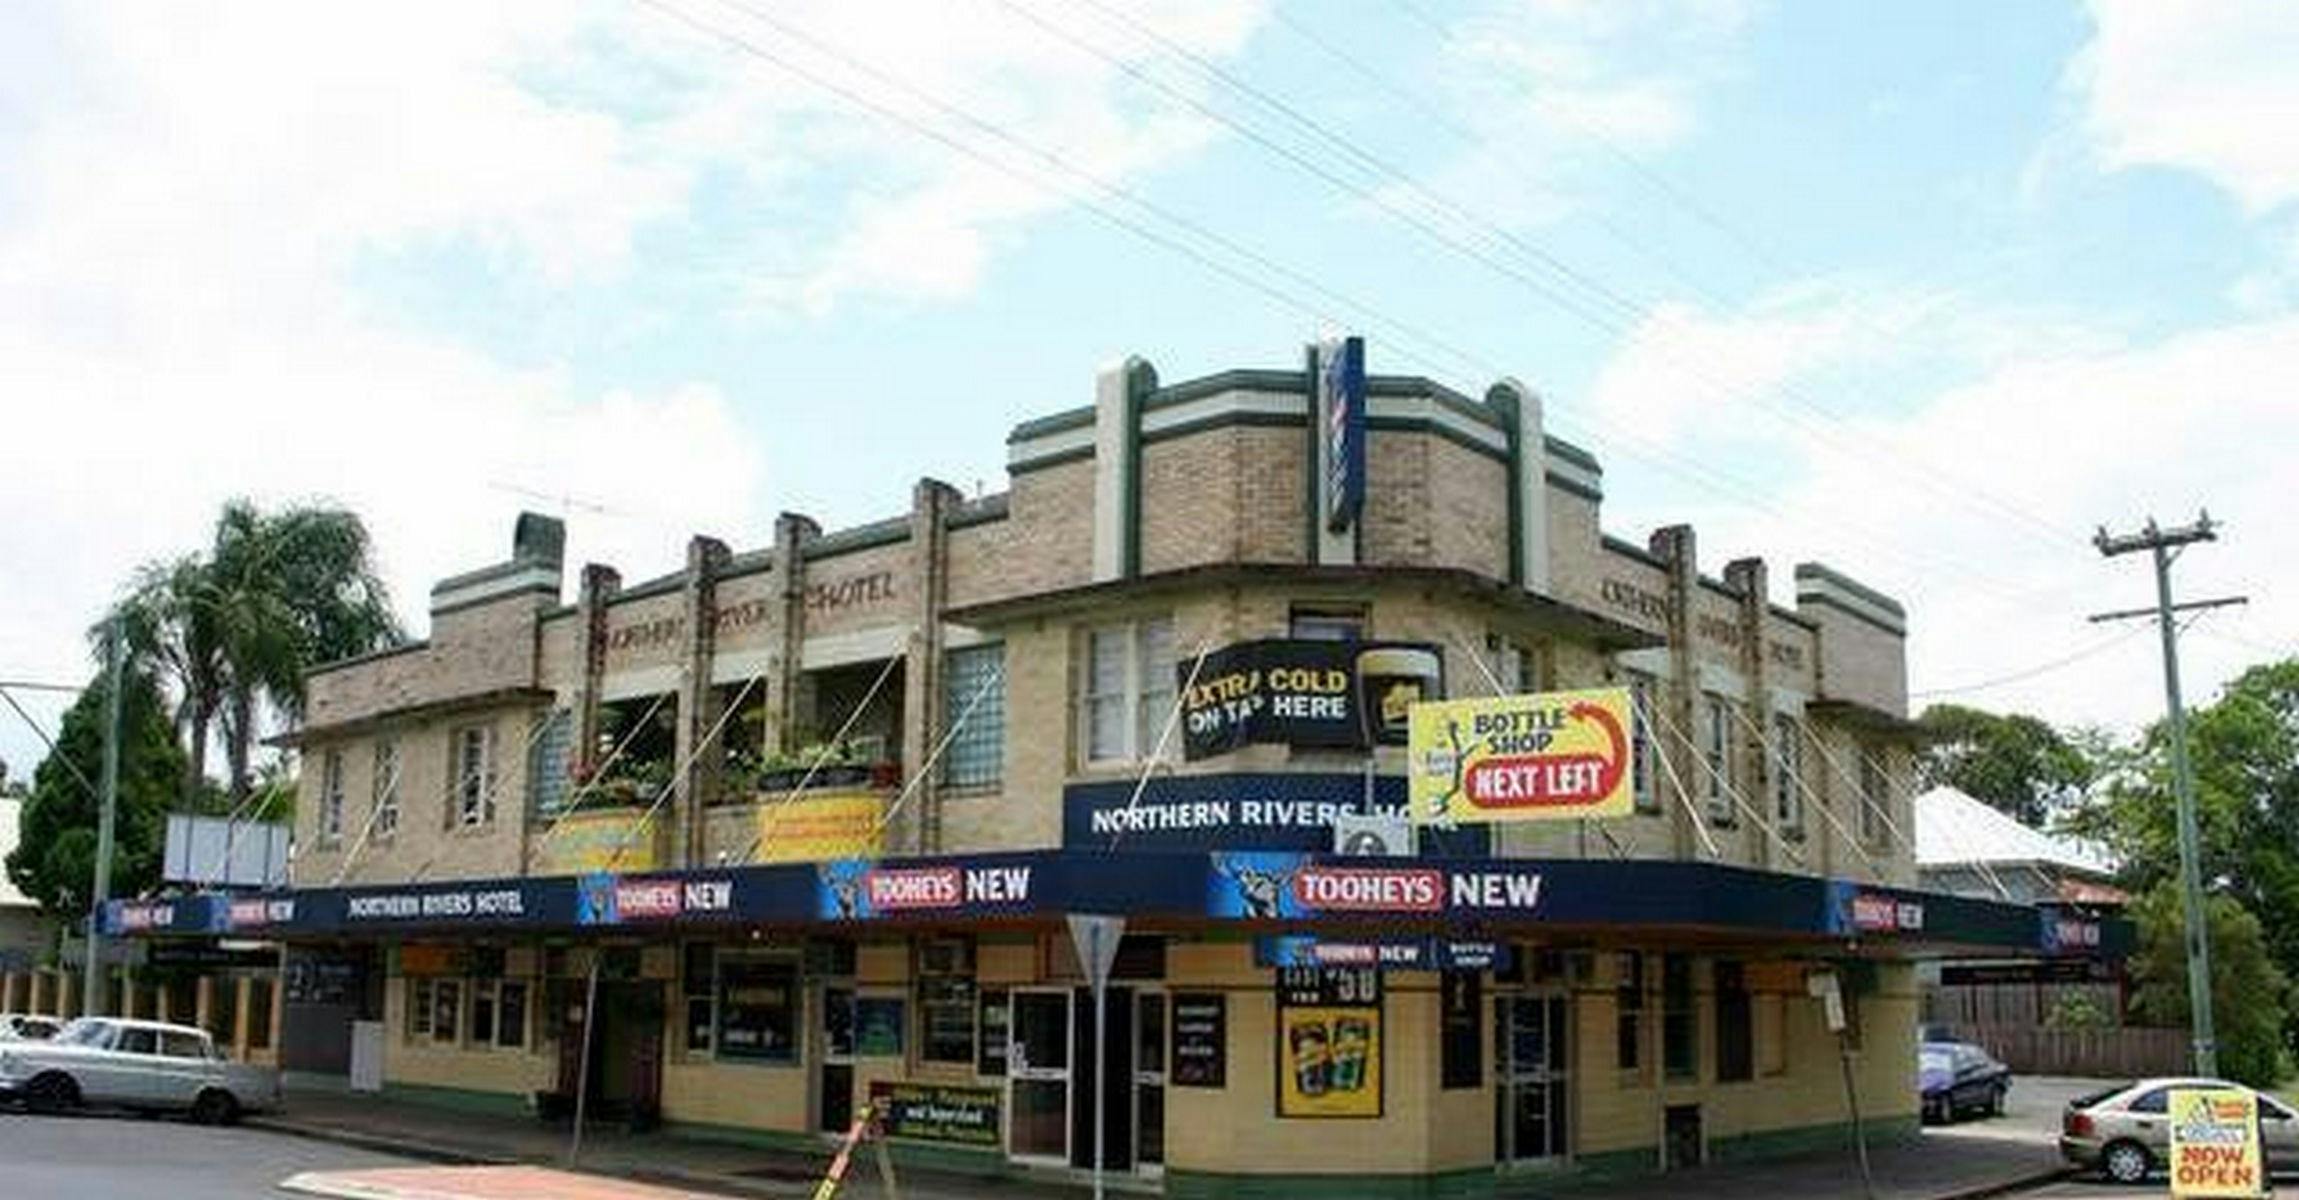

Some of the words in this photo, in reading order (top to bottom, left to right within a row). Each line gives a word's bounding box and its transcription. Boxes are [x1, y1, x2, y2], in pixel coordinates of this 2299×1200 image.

[1269, 667, 1348, 693] COLD
[1188, 707, 1222, 734] ON
[1273, 695, 1347, 719] HERE
[1474, 708, 1566, 735] BOTTLE
[1486, 733, 1554, 754] SHOP
[1475, 764, 1541, 798] NEXT
[1547, 761, 1604, 795] LEFT
[1091, 801, 1230, 833] NORTHERN
[685, 881, 733, 909] NEW
[965, 866, 1031, 901] NEW
[1302, 874, 1435, 903] TOOHEYS
[1452, 873, 1542, 907] NEW
[475, 890, 524, 914] HOTEL
[1379, 945, 1421, 961] NEW
[2181, 1145, 2244, 1166] NOW
[2176, 1165, 2253, 1186] OPEN
